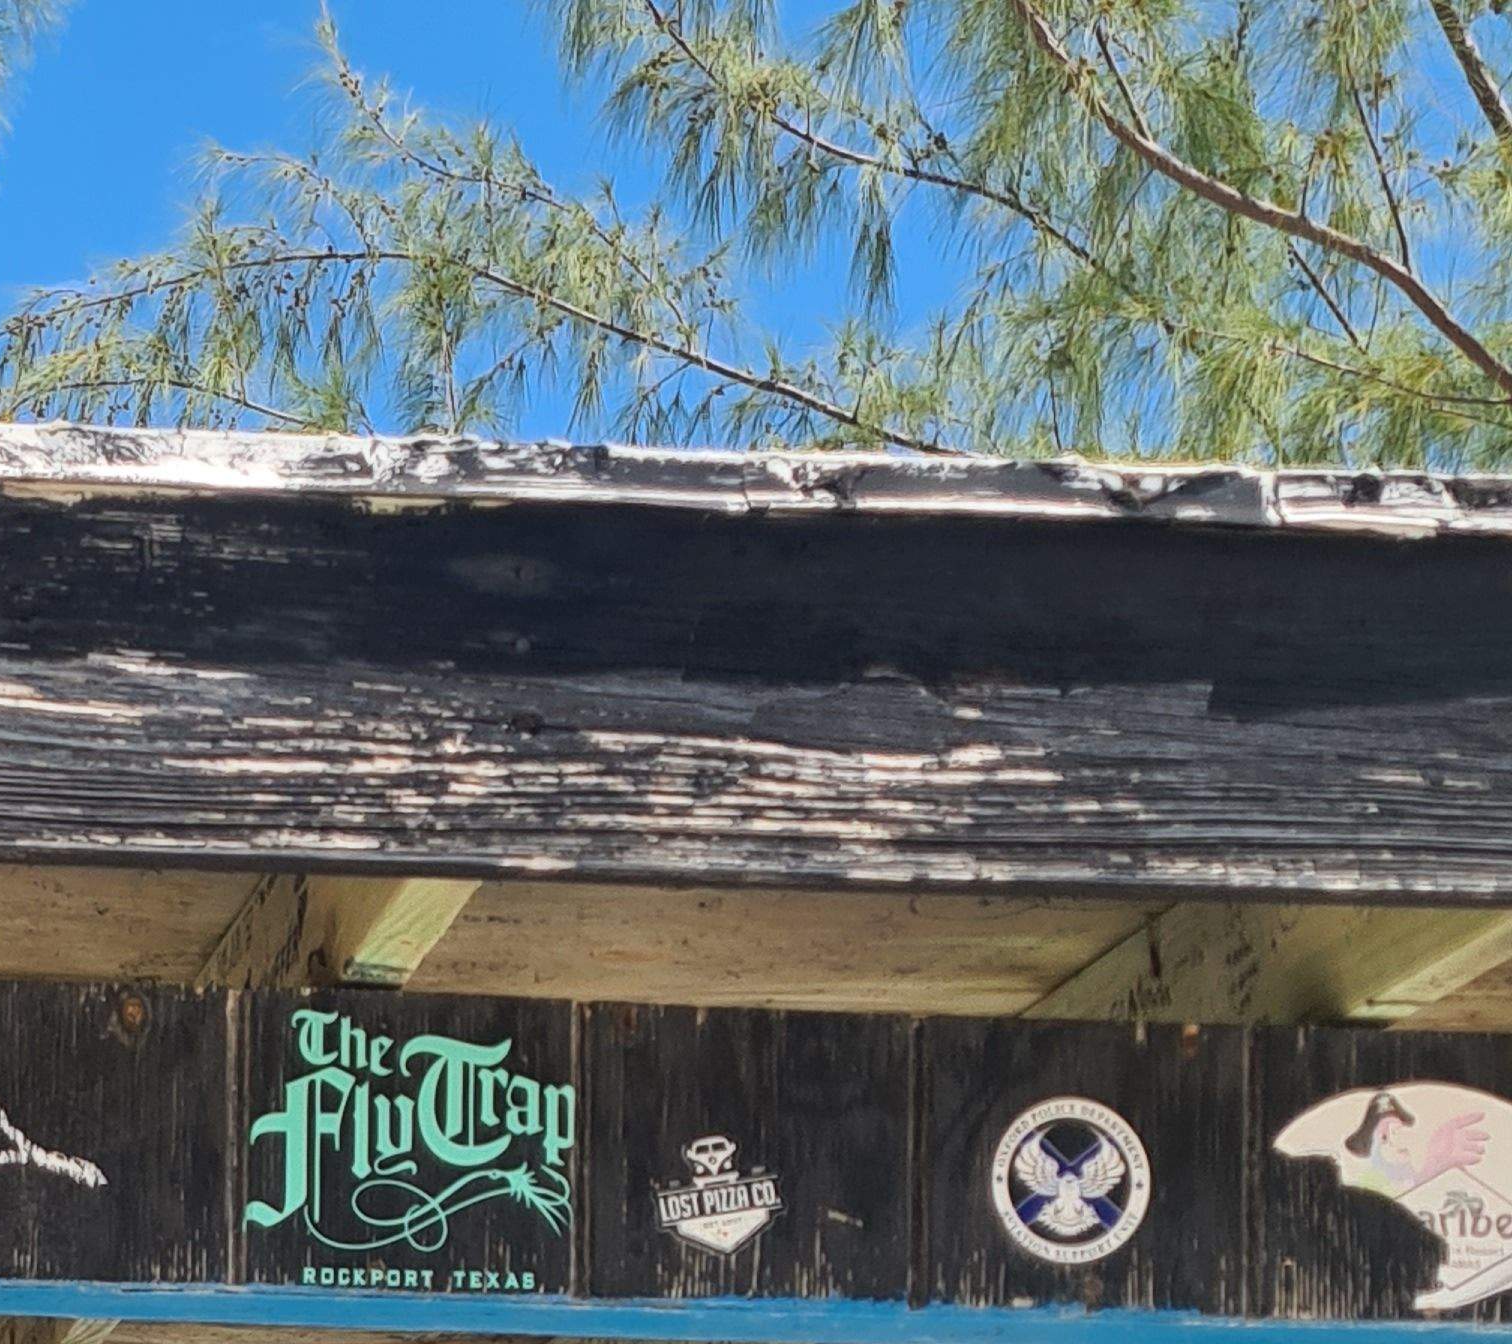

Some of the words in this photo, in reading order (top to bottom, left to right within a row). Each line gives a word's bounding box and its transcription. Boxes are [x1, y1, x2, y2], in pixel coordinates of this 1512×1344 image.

[291, 1008, 395, 1077] The
[242, 1066, 418, 1228] Fly
[399, 1034, 576, 1167] Trap
[658, 1192, 700, 1222] LOST
[702, 1186, 749, 1215] PIZZA
[751, 1179, 782, 1207] CO.
[302, 1266, 434, 1288] ROCKPORT
[453, 1270, 536, 1290] TEXAS
